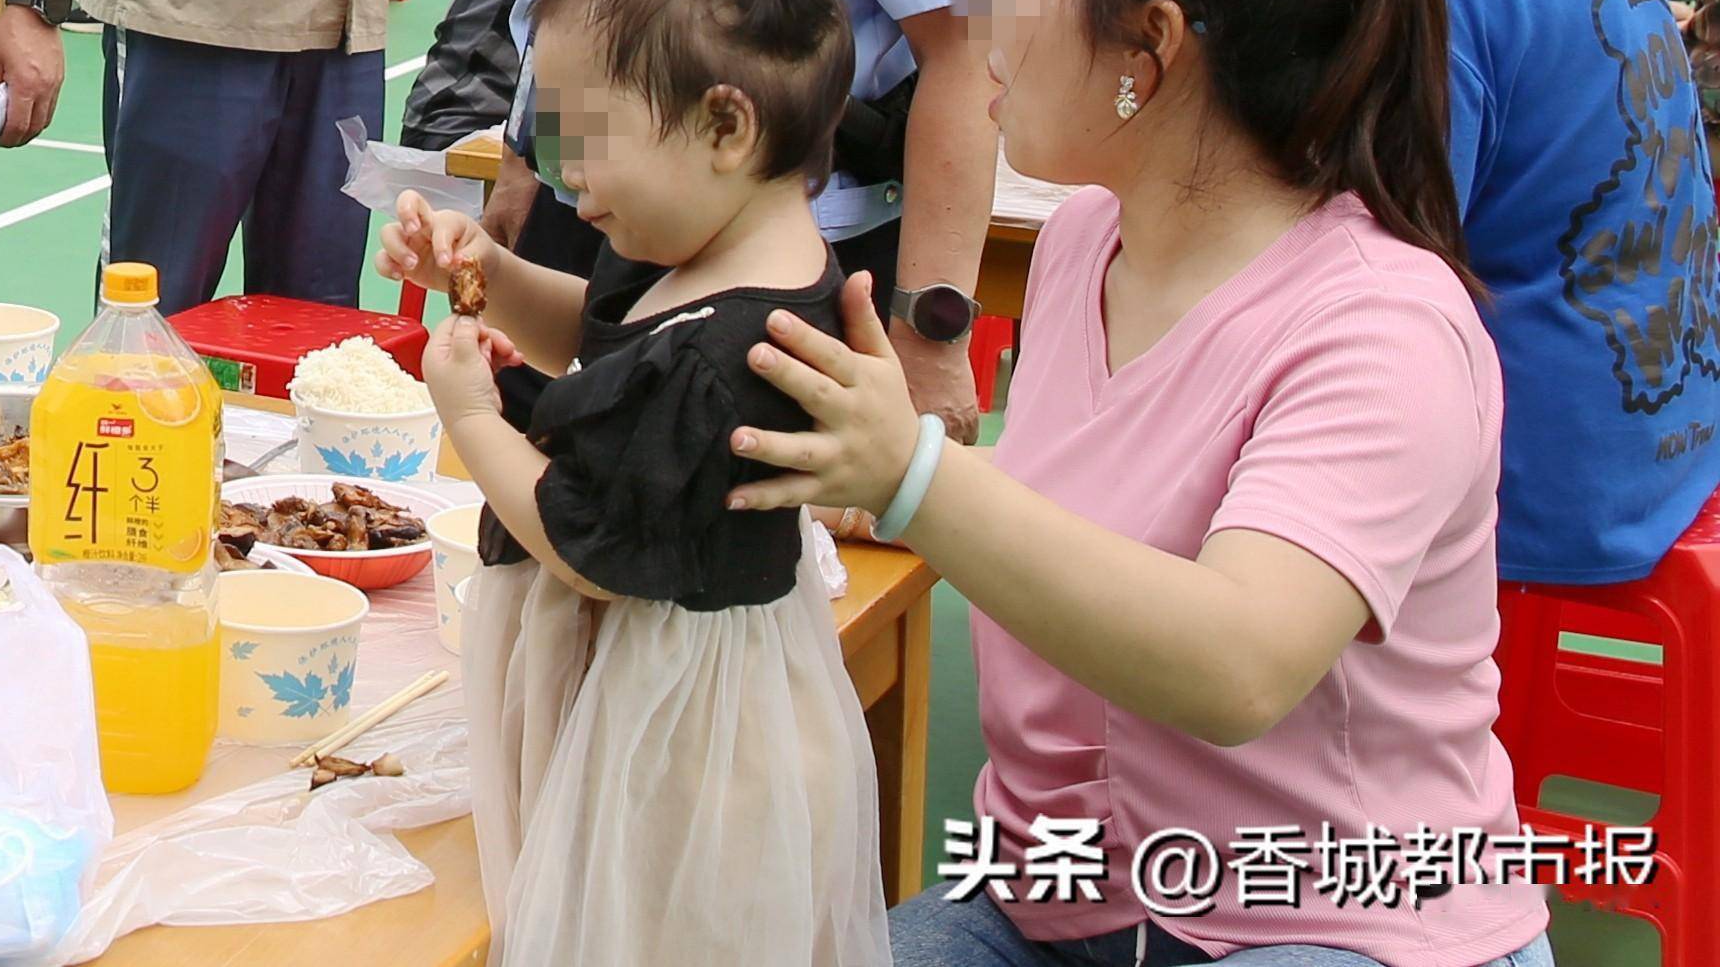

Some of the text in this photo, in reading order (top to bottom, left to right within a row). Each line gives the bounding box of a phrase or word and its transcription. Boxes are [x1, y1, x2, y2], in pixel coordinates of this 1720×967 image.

[64, 441, 110, 545] 纤
[131, 457, 159, 493] 3
[129, 494, 161, 514] 个半
